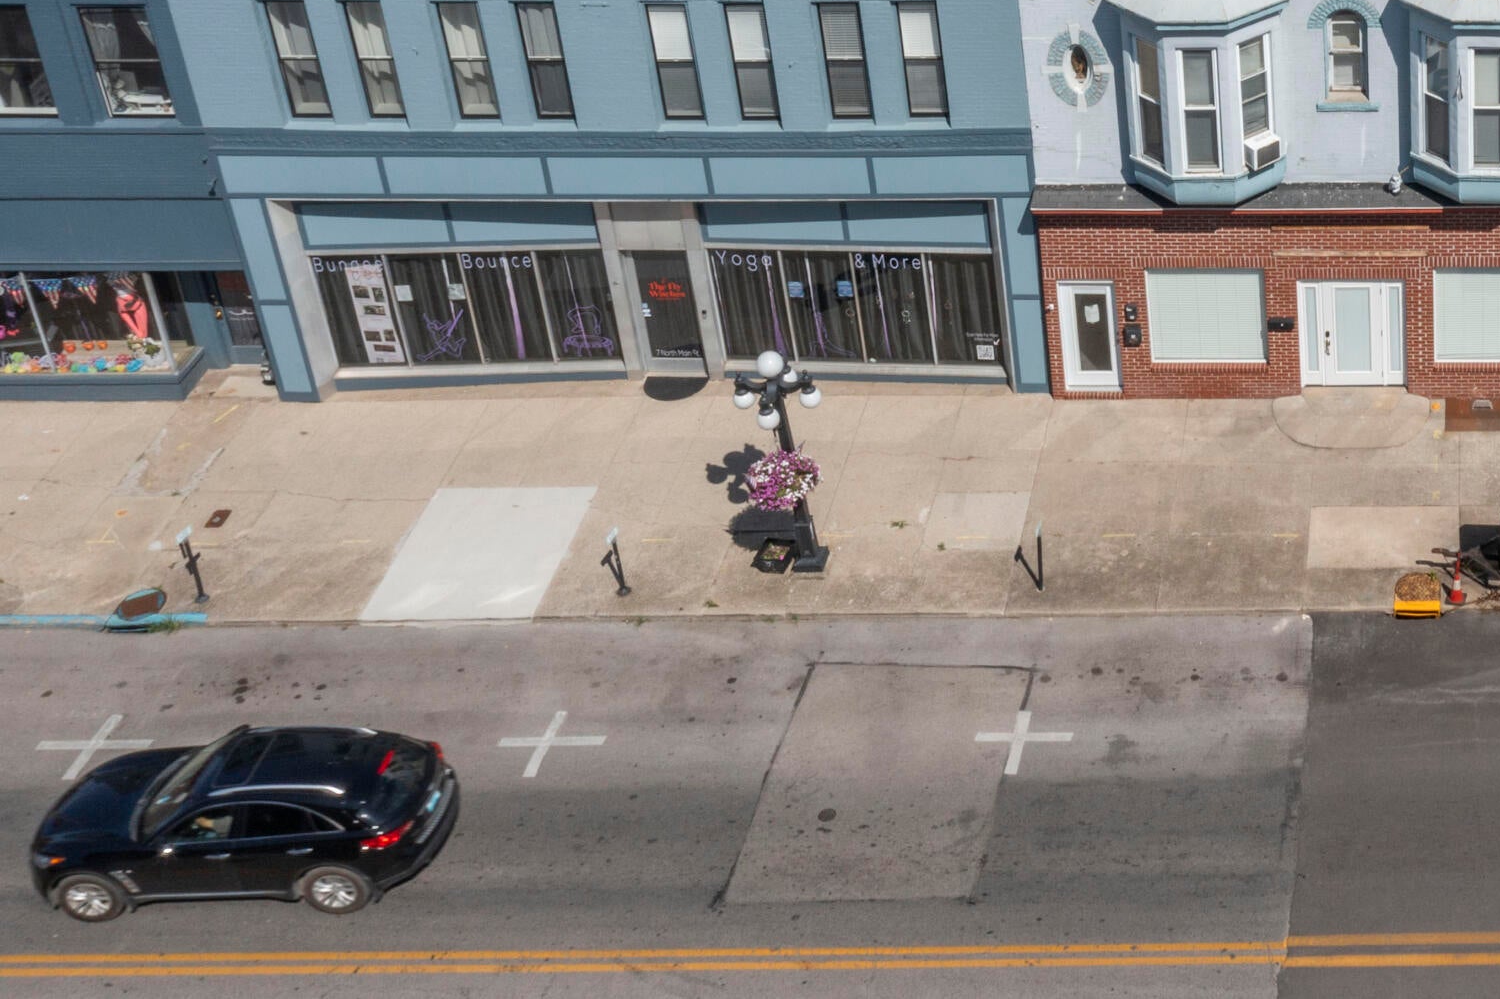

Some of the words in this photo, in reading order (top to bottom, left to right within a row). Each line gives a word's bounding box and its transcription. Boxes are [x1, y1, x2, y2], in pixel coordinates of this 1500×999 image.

[461, 253, 533, 270] Bounce
[715, 251, 773, 272] Yoga
[854, 253, 866, 269] &
[871, 253, 921, 270] More
